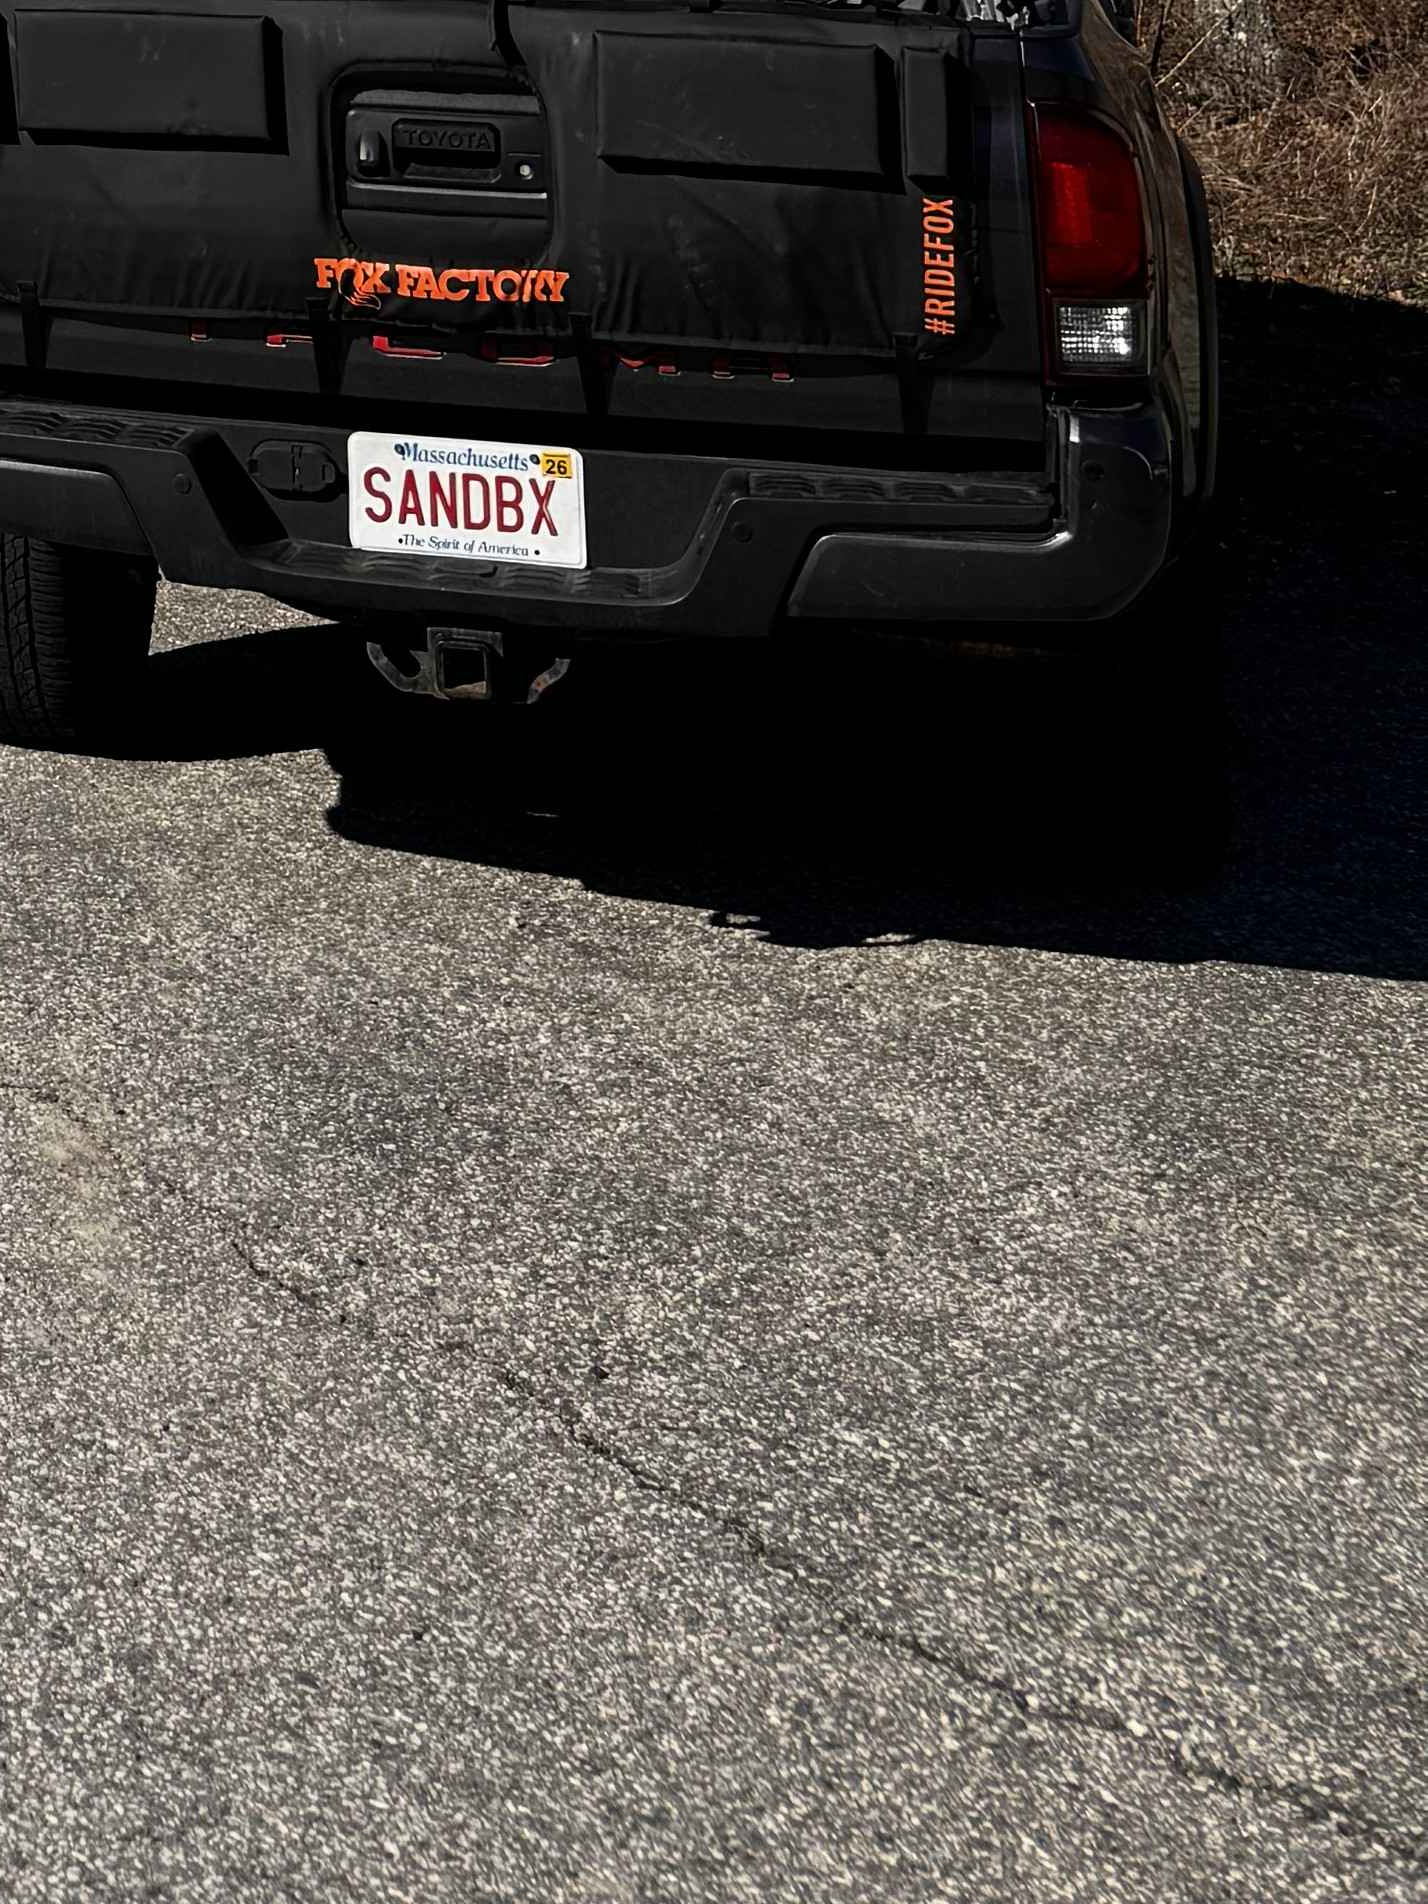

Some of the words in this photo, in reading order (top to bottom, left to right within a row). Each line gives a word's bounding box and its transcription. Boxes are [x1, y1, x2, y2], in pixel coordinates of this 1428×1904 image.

[403, 128, 491, 150] TOYOTA
[314, 257, 391, 302] FOX
[395, 264, 570, 303] FACTORY
[922, 198, 956, 335] #RIDEFOX
[401, 442, 529, 471] Massachusetts
[545, 458, 568, 475] 26
[363, 466, 558, 537] SANDBX
[403, 534, 425, 549] The
[428, 535, 460, 551] Spirit
[463, 539, 475, 553] of
[478, 541, 530, 557] America
